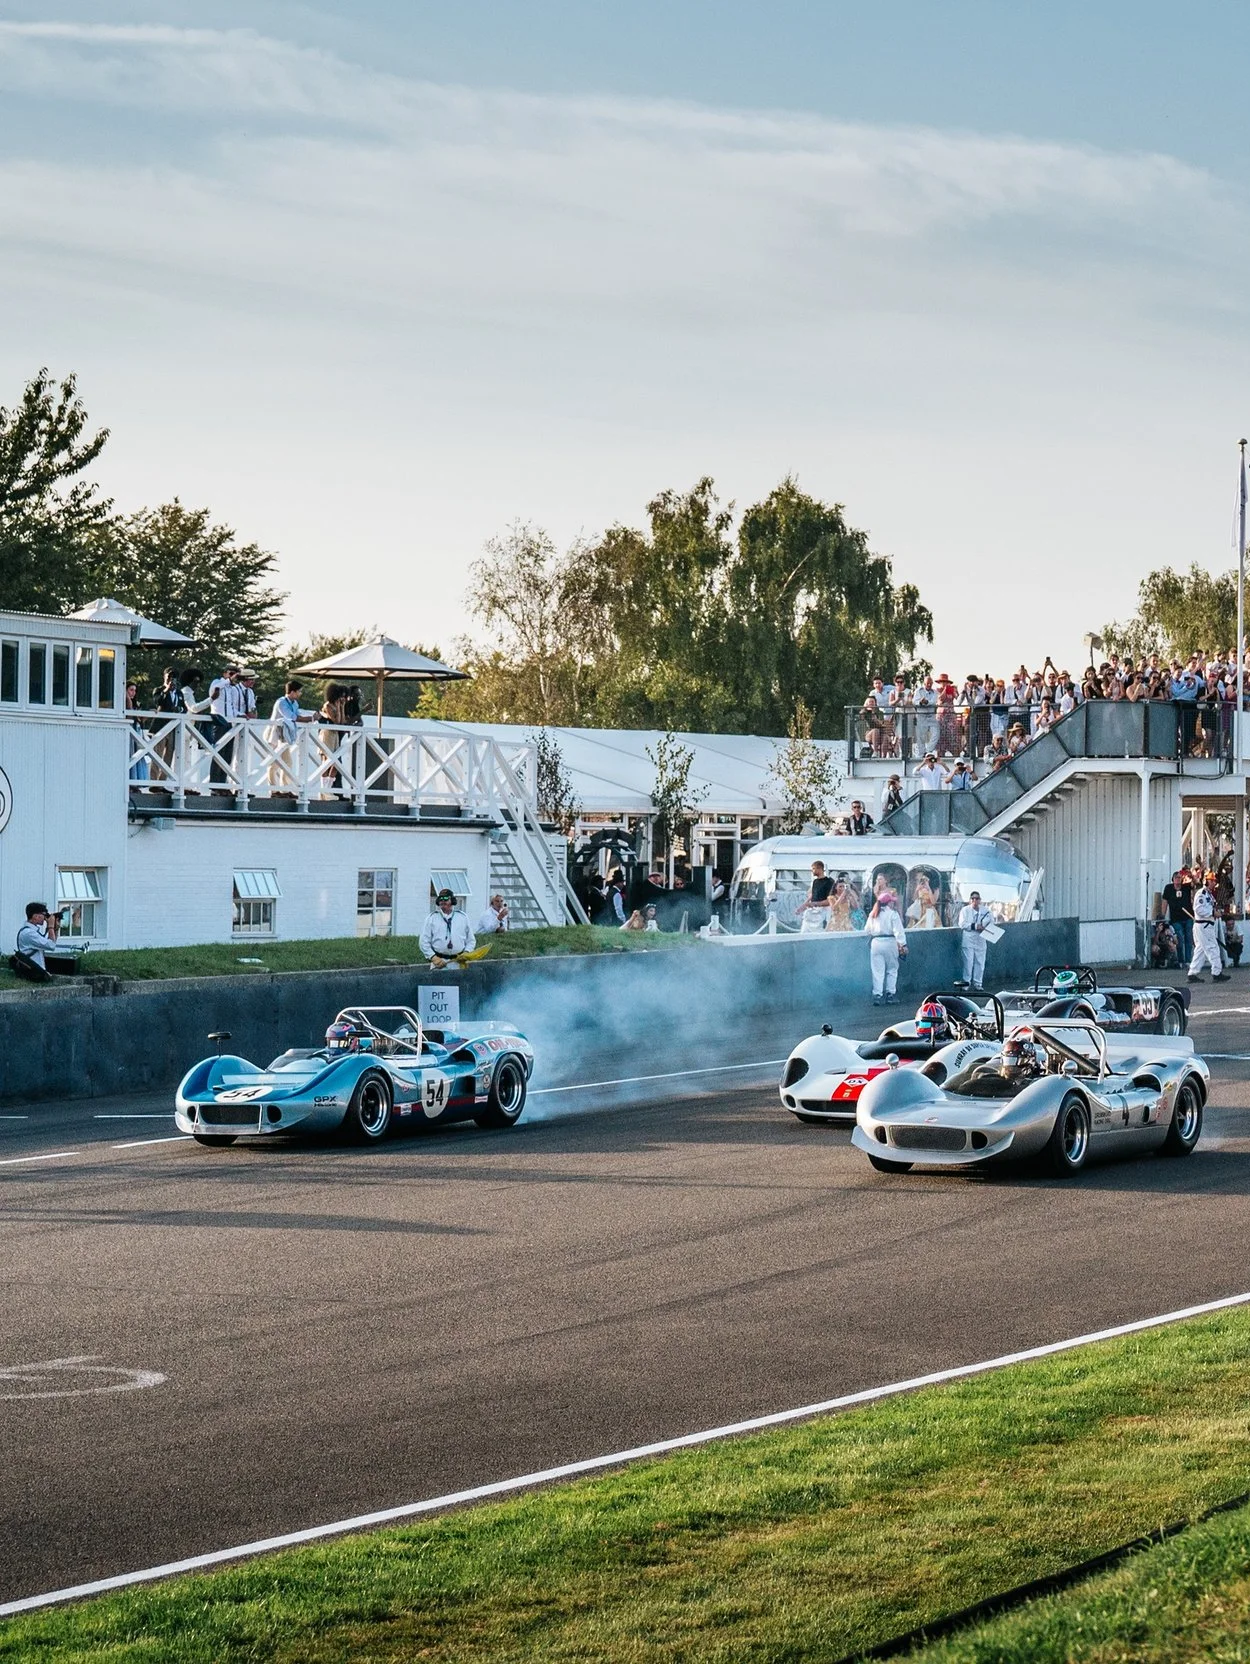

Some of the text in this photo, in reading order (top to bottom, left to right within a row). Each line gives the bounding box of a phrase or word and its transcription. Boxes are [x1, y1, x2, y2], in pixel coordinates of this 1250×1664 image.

[431, 991, 446, 1000] PIT
[429, 1003, 449, 1012] OUT
[427, 1015, 452, 1024] LOOP
[223, 1089, 263, 1099] 54
[426, 1078, 445, 1108] 54
